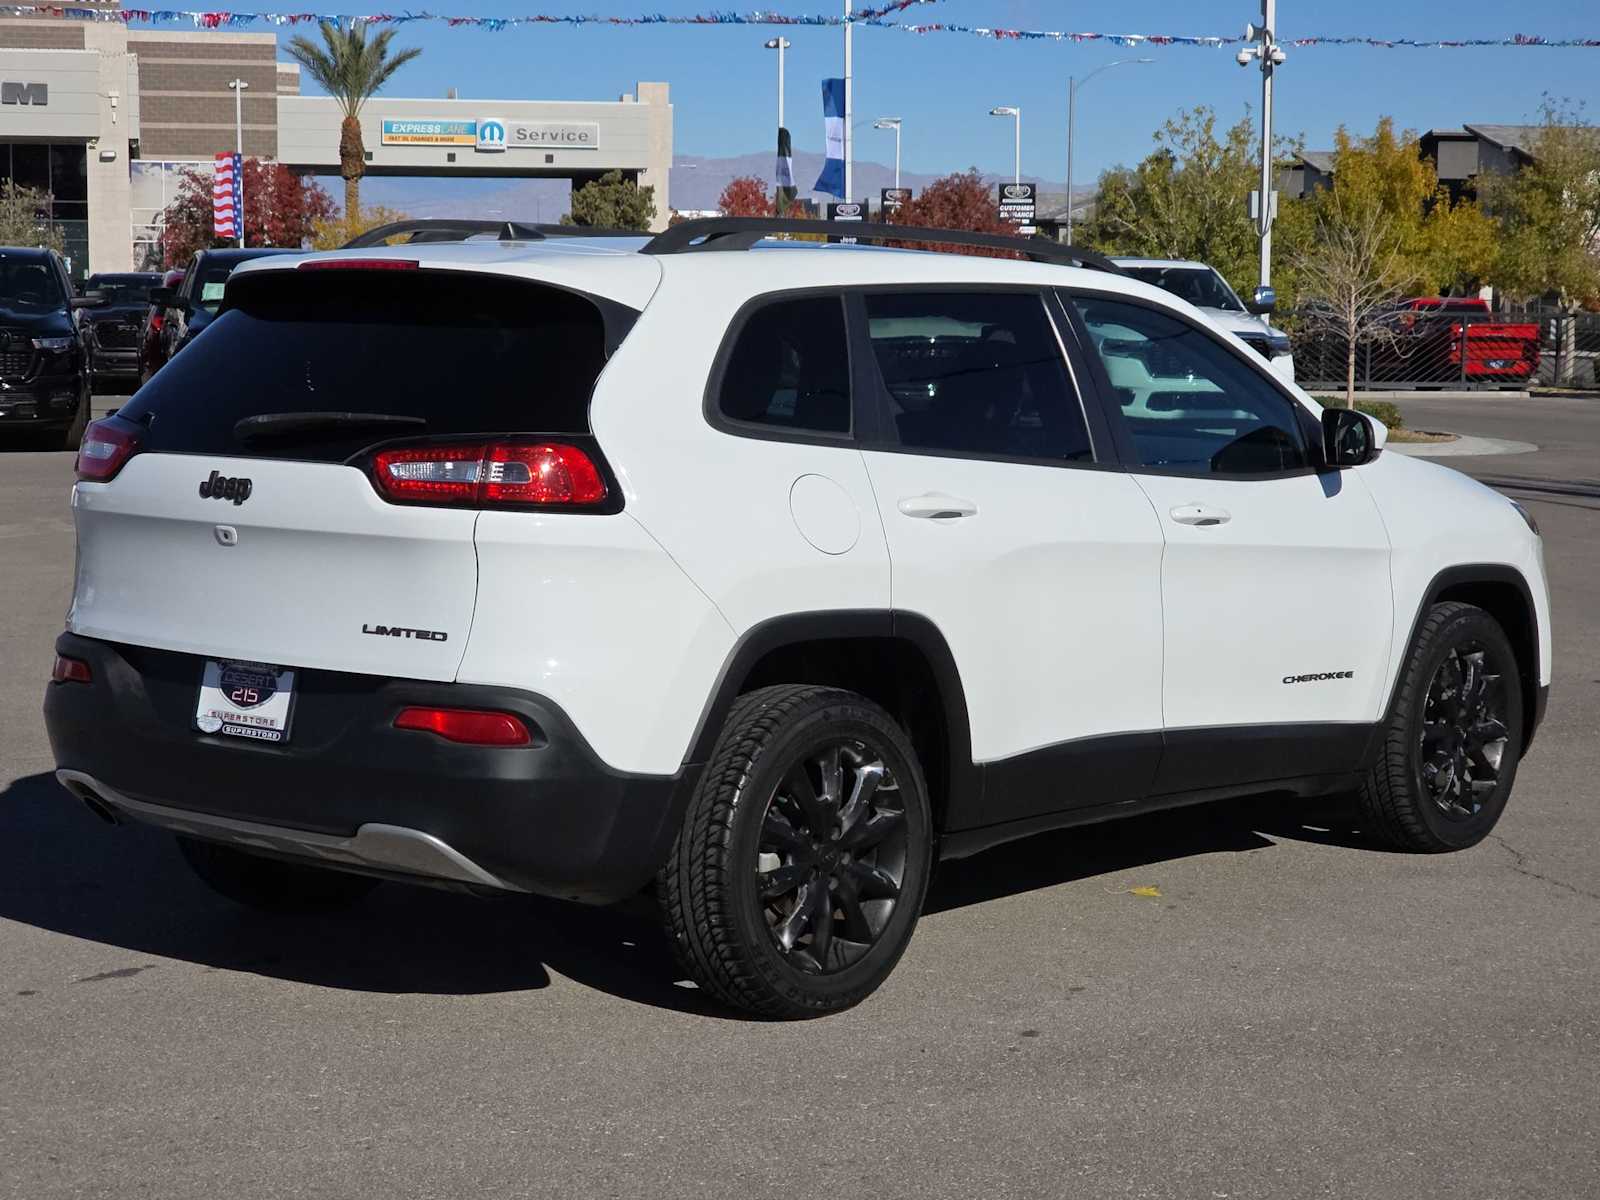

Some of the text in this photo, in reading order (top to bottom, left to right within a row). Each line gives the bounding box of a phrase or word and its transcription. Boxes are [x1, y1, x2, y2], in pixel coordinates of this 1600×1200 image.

[516, 127, 589, 142] Service
[362, 623, 448, 642] LIMITED
[1282, 670, 1354, 684] CHEROKEE
[231, 688, 258, 702] 215
[211, 711, 275, 726] SUPERSTORE
[225, 725, 278, 740] SUPERSTORE
